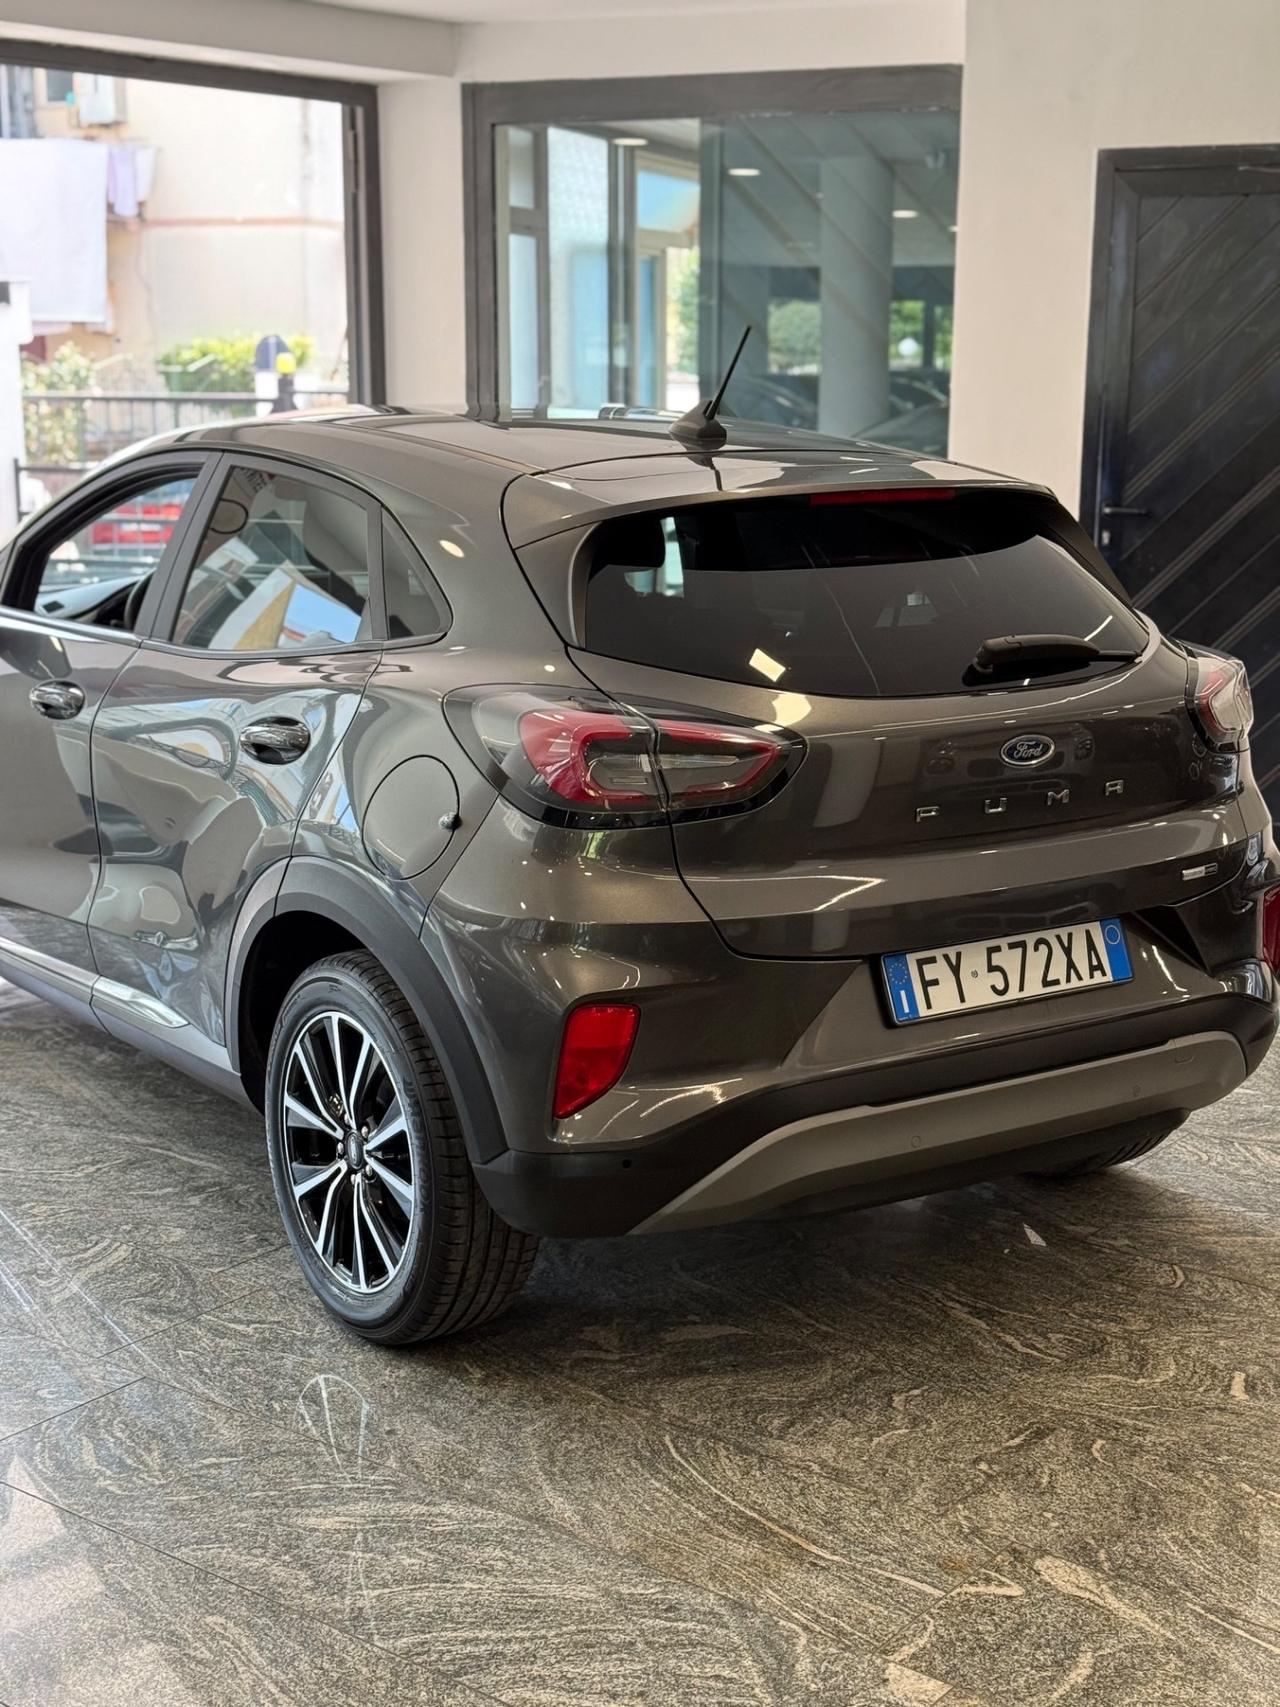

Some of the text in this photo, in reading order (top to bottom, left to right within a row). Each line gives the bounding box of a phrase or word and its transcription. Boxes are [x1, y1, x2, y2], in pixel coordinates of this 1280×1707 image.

[1013, 741, 1044, 759] Ford
[915, 779, 1125, 823] PUMA
[915, 951, 966, 1010] FY
[985, 928, 1108, 997] 572XA
